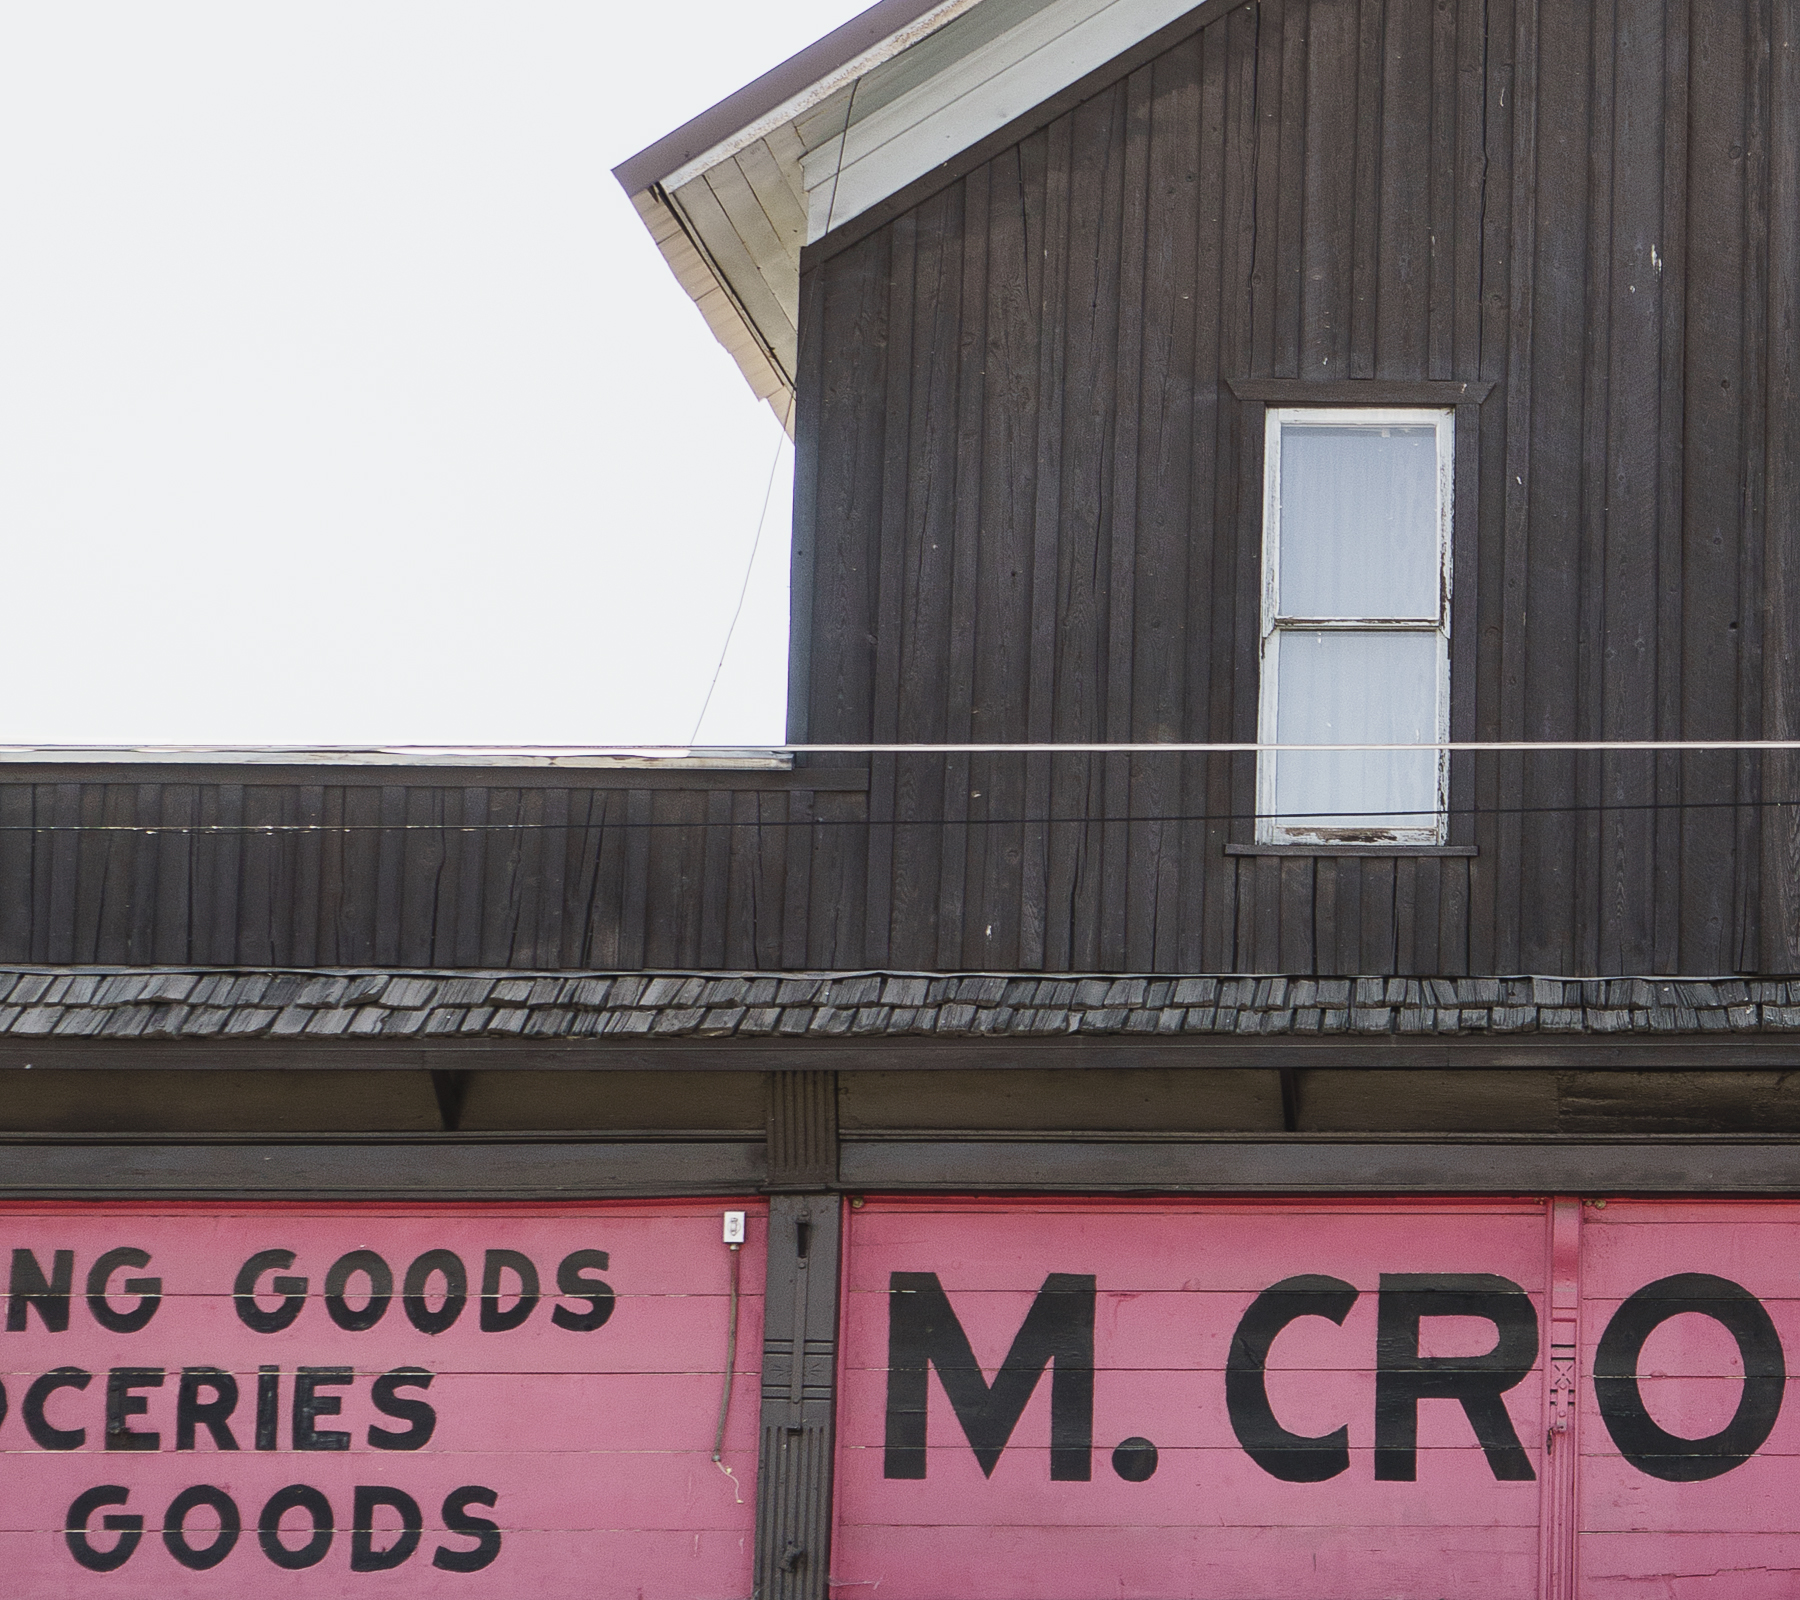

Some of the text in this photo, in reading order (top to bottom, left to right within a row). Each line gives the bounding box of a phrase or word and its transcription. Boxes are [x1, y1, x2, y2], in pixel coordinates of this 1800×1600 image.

[5, 1245, 618, 1335] NG GOODS
[0, 1364, 438, 1452] CERIES
[883, 1271, 1159, 1483] M.
[64, 1483, 503, 1573] GOODS
